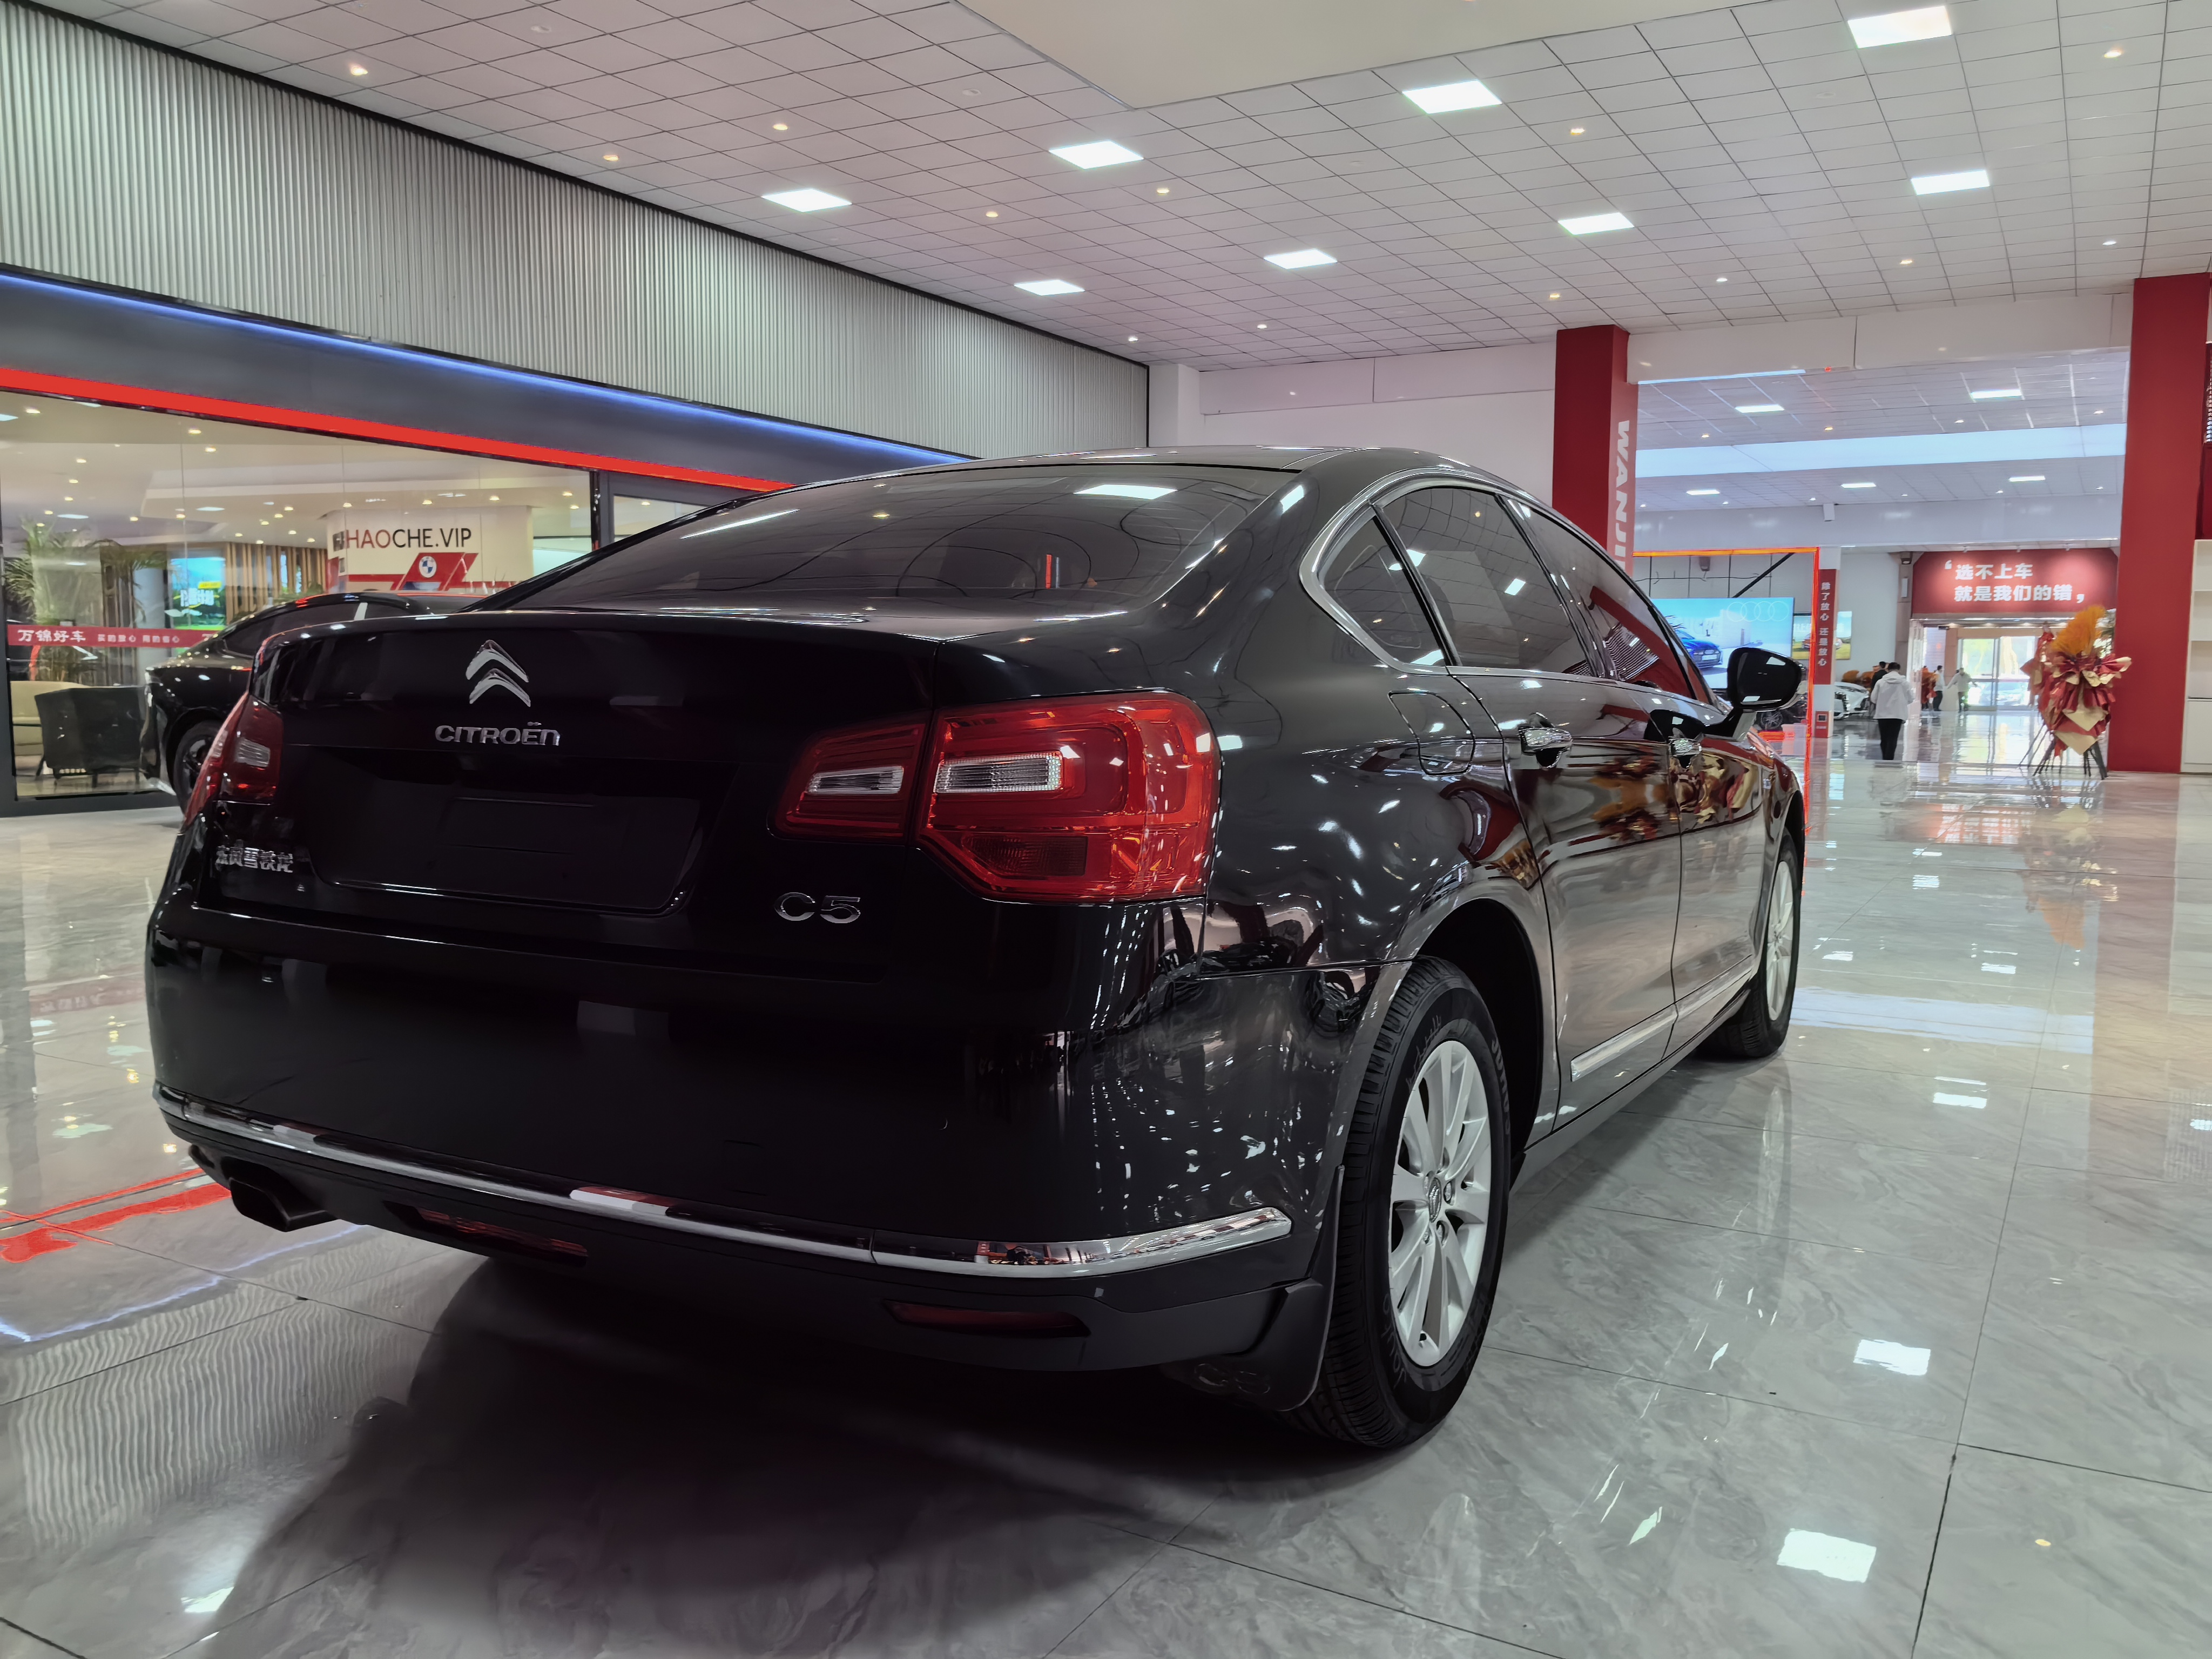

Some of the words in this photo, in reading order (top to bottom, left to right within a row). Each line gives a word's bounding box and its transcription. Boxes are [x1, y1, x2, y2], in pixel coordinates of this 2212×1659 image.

[346, 528, 471, 549] HAOCHE.VIP
[17, 629, 86, 643] 万锦好车
[774, 892, 861, 924] C5
